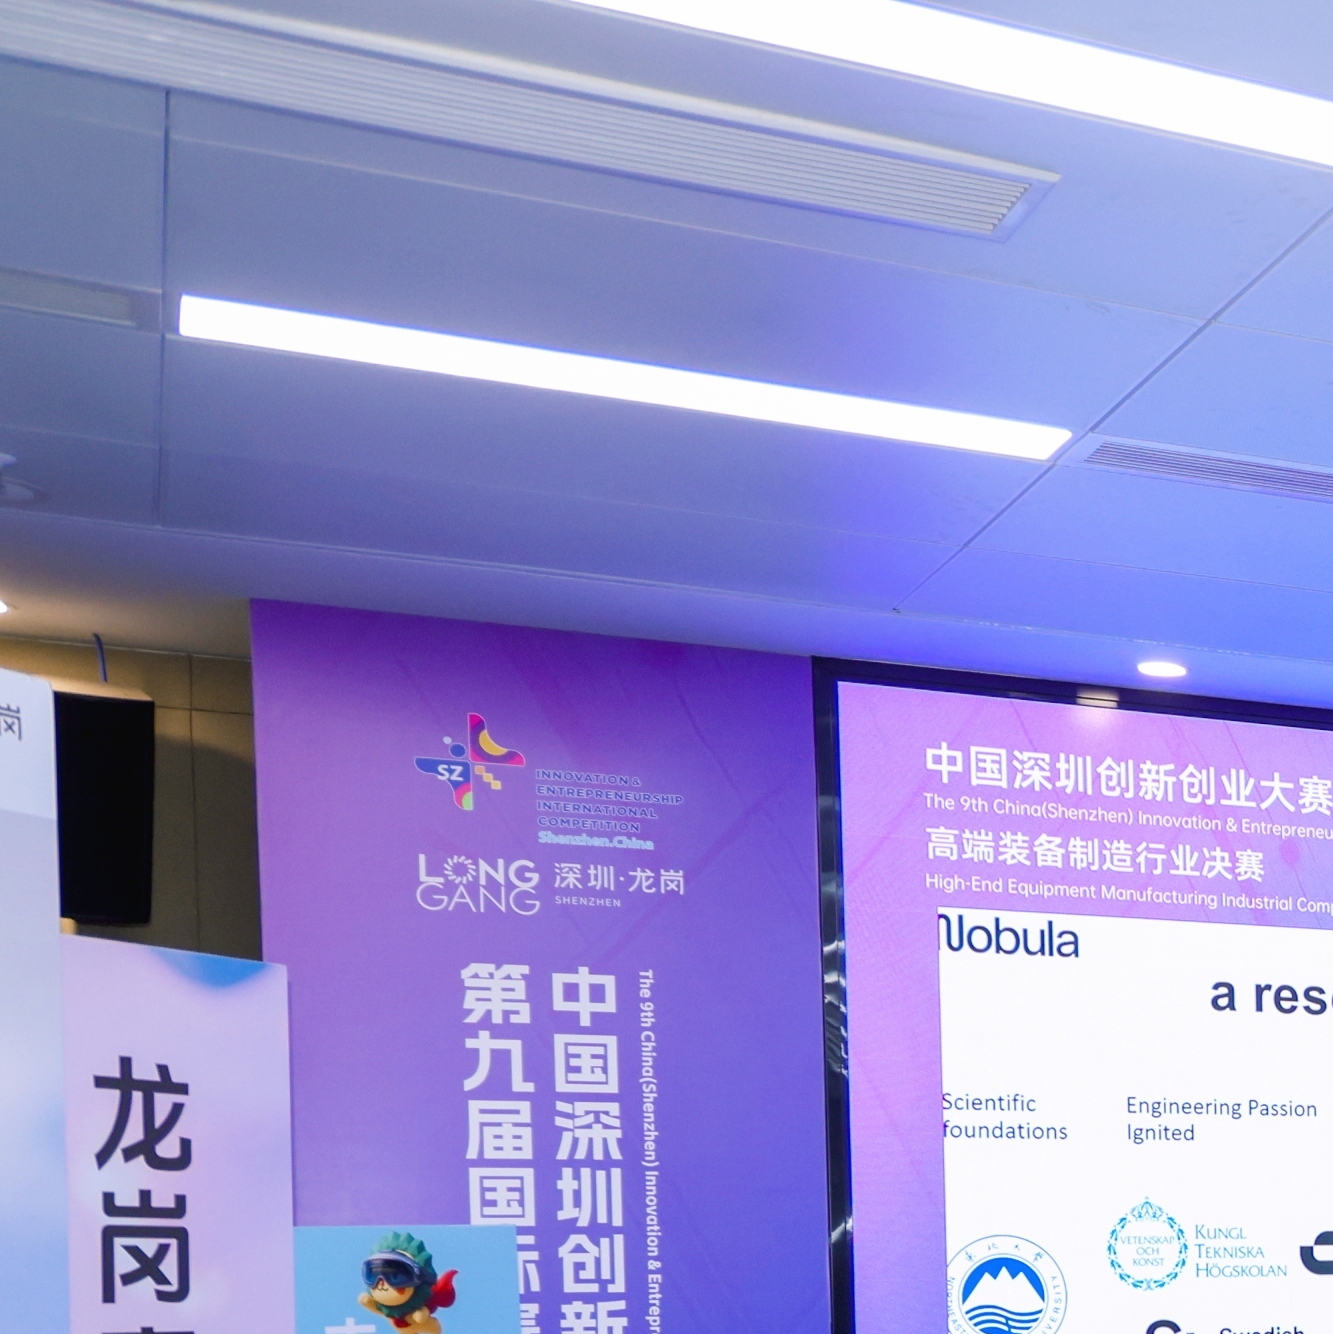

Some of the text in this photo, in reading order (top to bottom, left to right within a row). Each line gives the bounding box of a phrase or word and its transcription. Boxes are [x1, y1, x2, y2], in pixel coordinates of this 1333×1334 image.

[437, 763, 464, 782] SZ
[535, 768, 632, 787] INNOVATION
[535, 784, 684, 805] ENTREPRENEURSHIP
[536, 800, 658, 819] INTERNATIONAL
[923, 791, 956, 812] The
[959, 795, 988, 814] 9th
[993, 798, 1134, 826] China(Shenzhen)
[1137, 809, 1222, 831] Innovation
[537, 816, 641, 833] COMPETITION
[924, 825, 1265, 883] 高端装备制造行业决赛
[417, 853, 540, 888] LONG
[415, 881, 541, 916] GANG
[554, 894, 622, 908] SHENZHEN
[925, 872, 1003, 893] High-End
[1007, 877, 1097, 899] Equipment
[1100, 884, 1219, 910] Manufacturing
[1221, 891, 1293, 912] Industrial
[637, 968, 654, 999] The
[1210, 980, 1237, 1012] a
[639, 1001, 655, 1028] 9th
[941, 1092, 1037, 1113] Scientific
[1126, 1096, 1318, 1119] Engineering Passion
[942, 1120, 1069, 1141] foundations
[1127, 1123, 1196, 1145] Ignited
[644, 1170, 662, 1257] Innovation
[1194, 1244, 1265, 1259] TEKNISKA
[1195, 1261, 1288, 1278] HÖGSKOLAN
